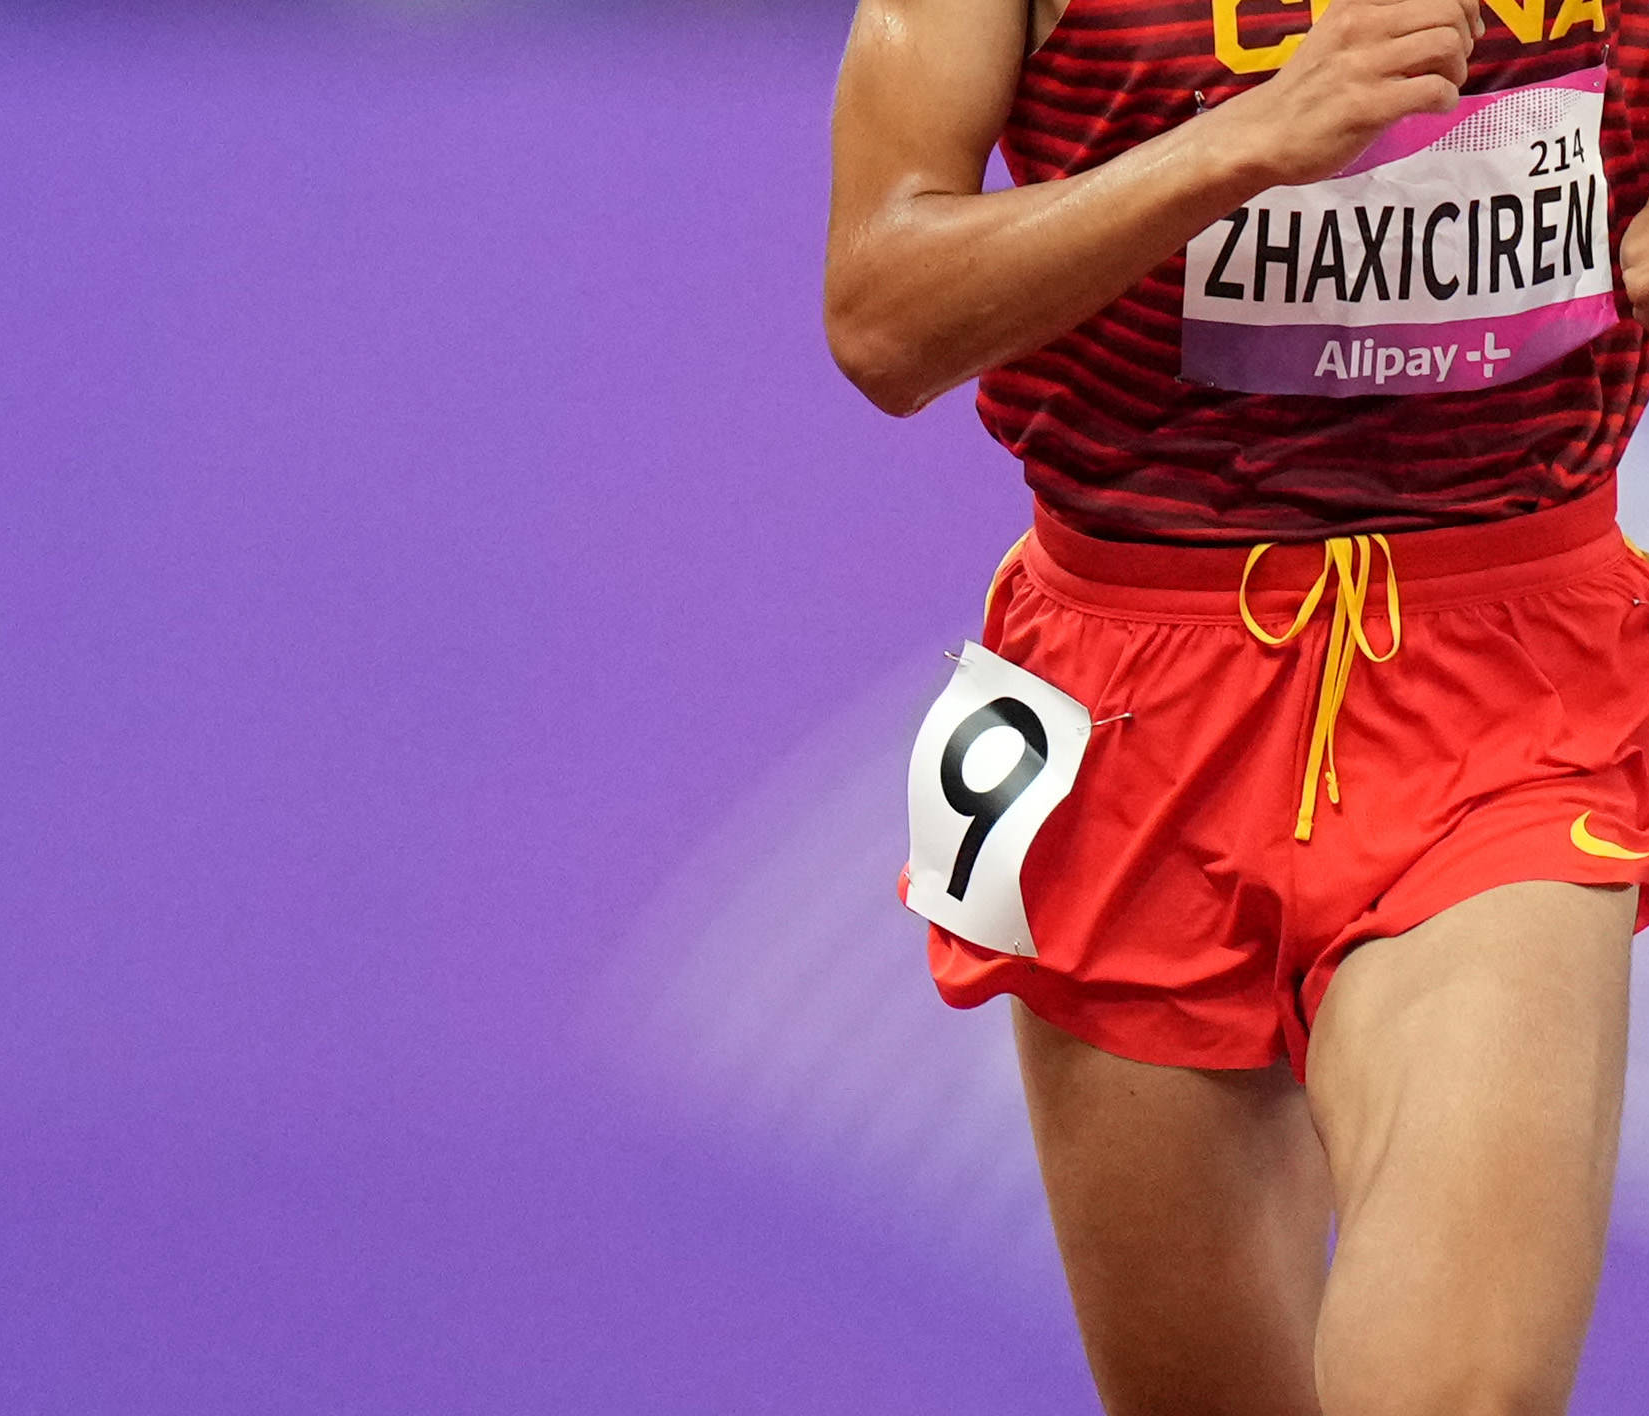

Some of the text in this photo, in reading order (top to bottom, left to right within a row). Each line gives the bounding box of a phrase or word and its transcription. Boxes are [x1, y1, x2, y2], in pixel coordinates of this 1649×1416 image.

[1529, 128, 1585, 177] 214
[1204, 174, 1596, 304] ZHAXICIREN
[940, 696, 1048, 902] 9
